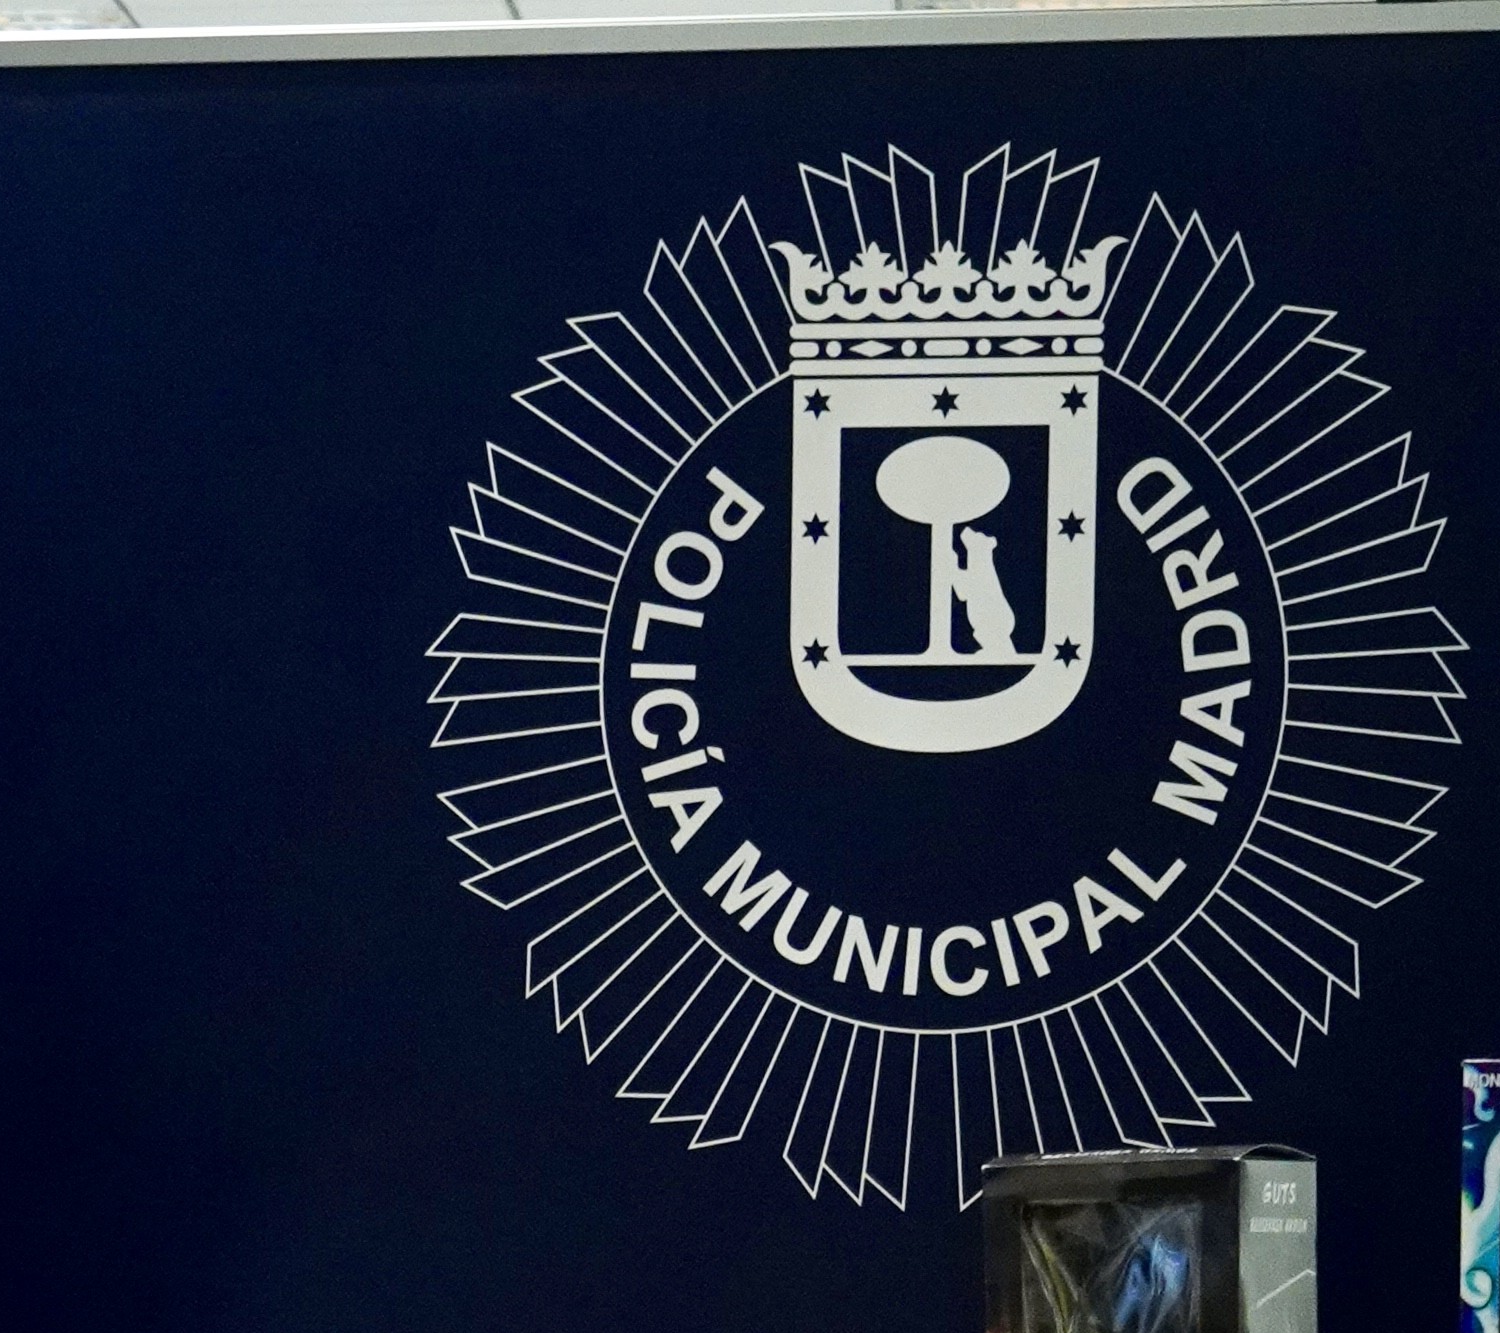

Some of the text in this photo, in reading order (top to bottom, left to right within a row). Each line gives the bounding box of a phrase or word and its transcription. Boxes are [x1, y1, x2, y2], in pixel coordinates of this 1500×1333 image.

[629, 453, 1253, 998] POLICÍA MUNICIPAL MADRID
[1262, 1181, 1296, 1205] GUTS
